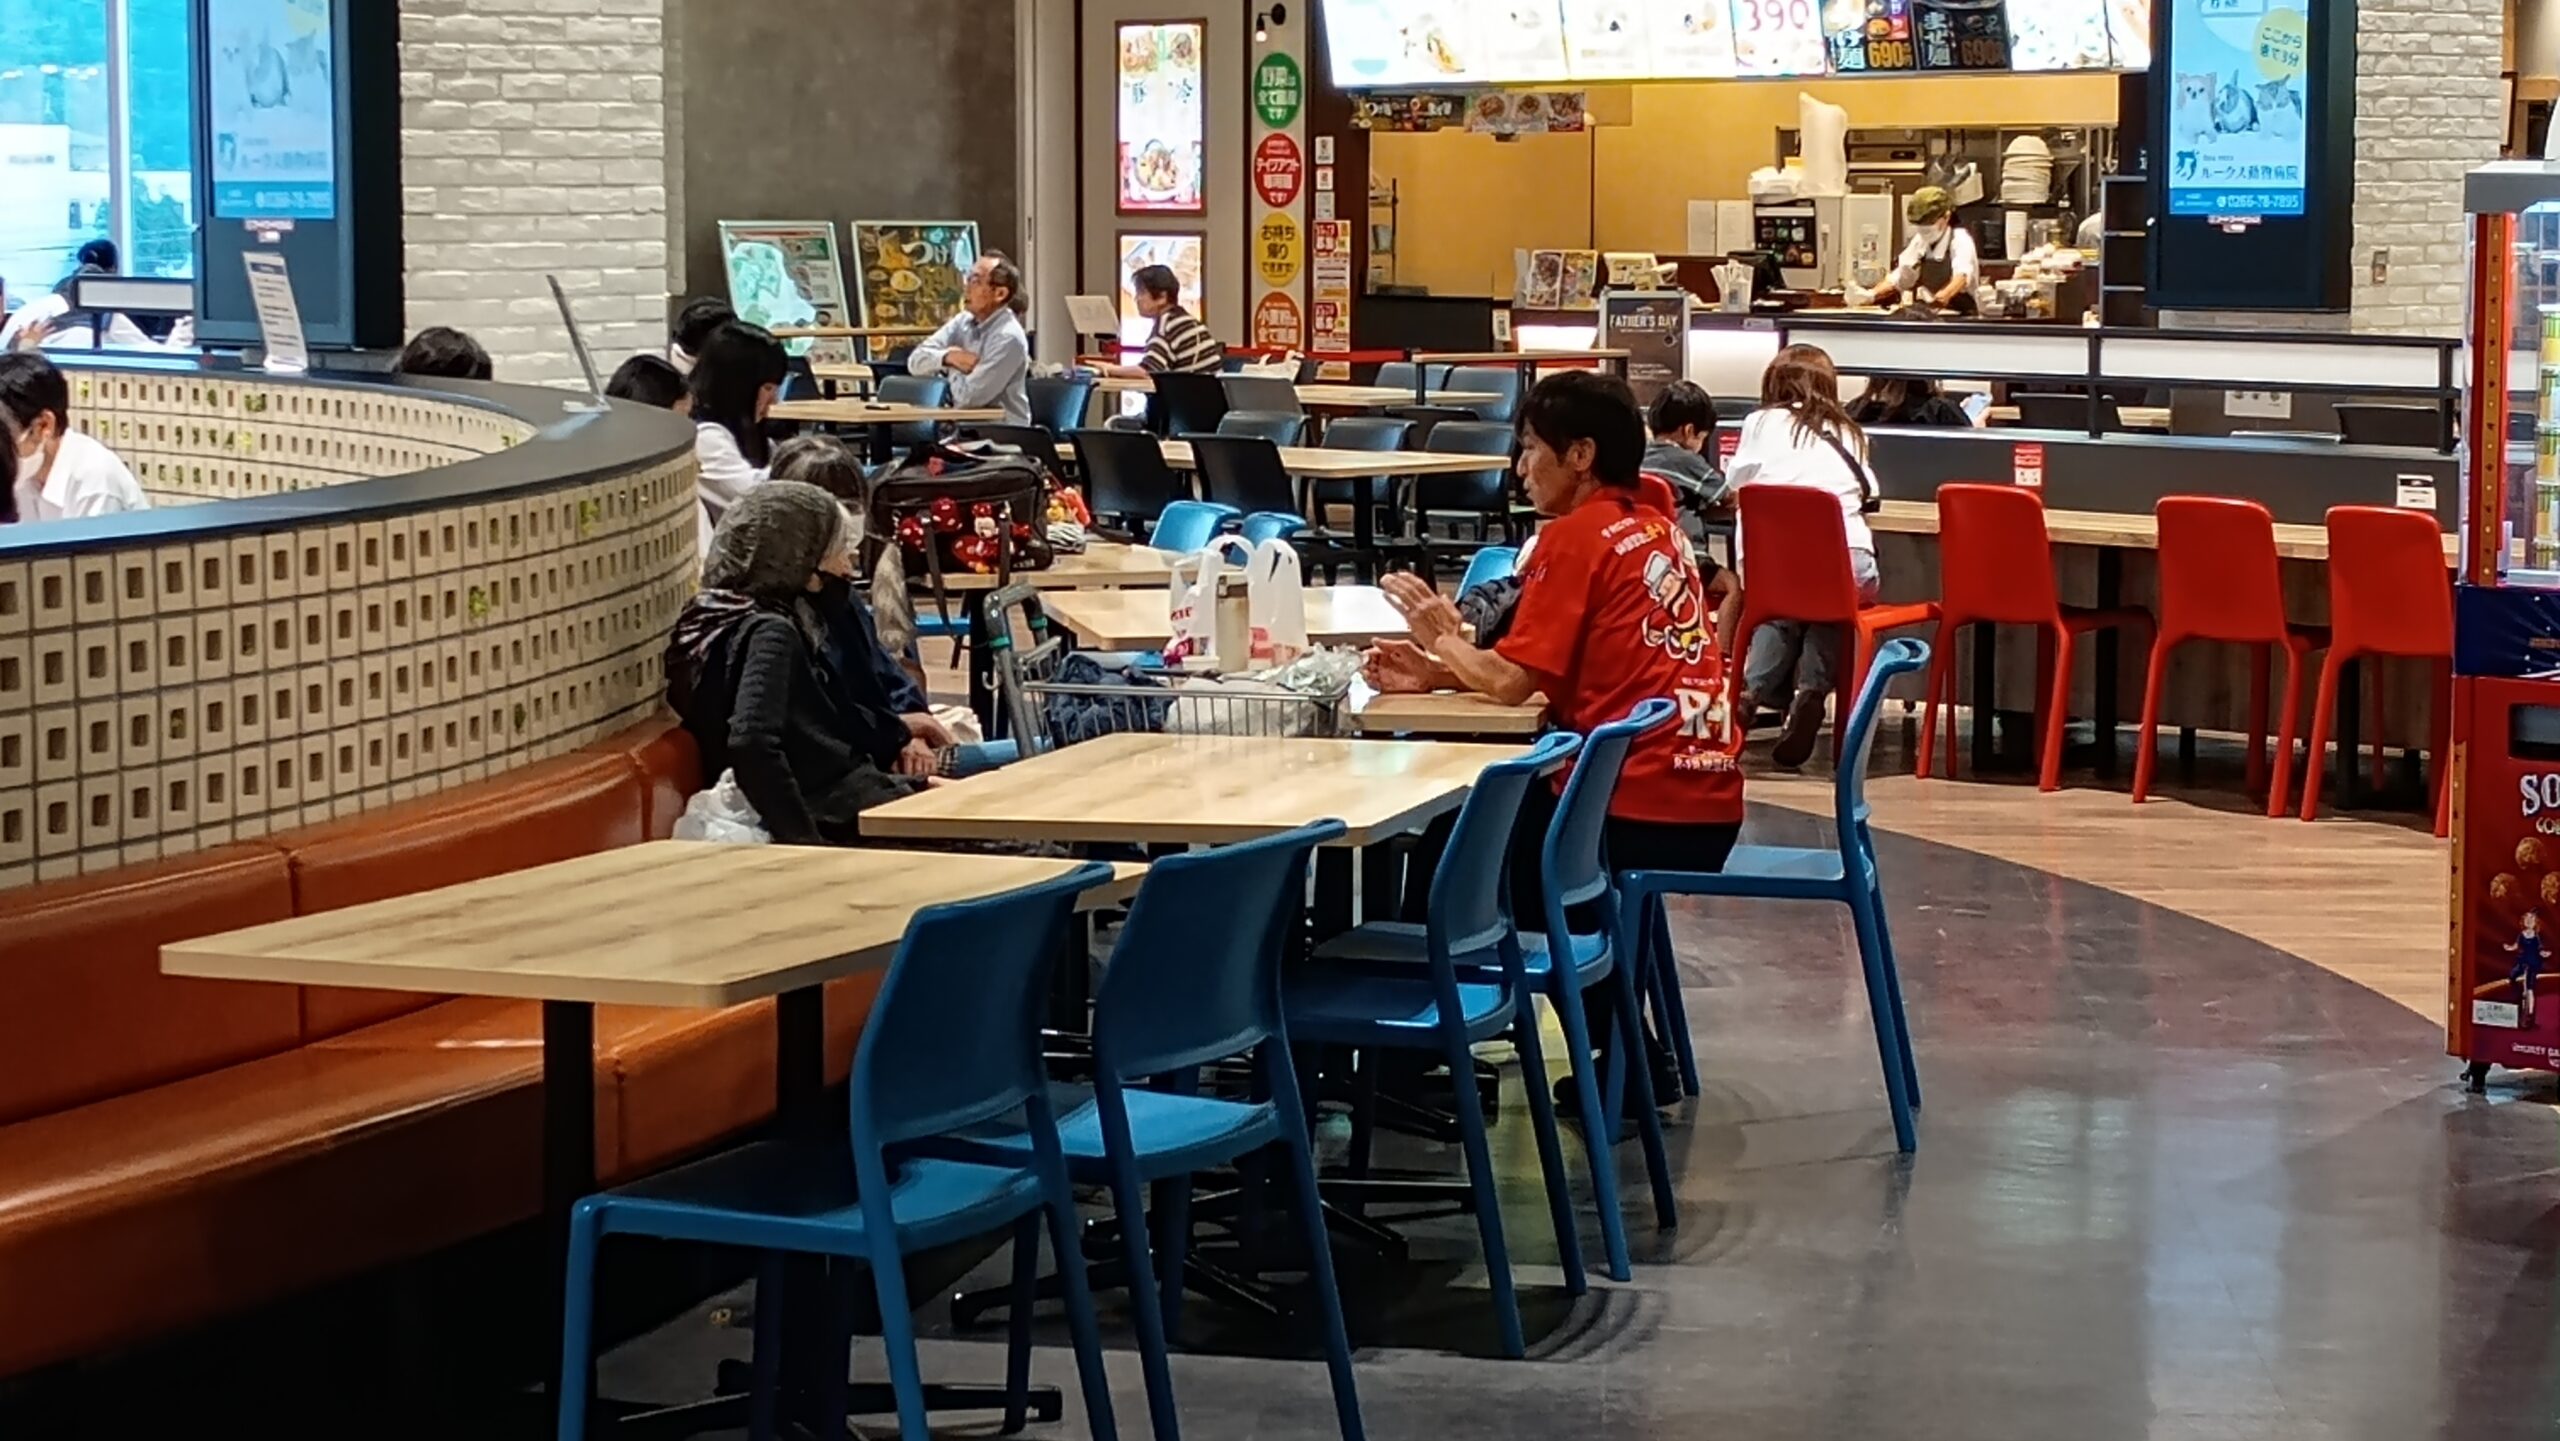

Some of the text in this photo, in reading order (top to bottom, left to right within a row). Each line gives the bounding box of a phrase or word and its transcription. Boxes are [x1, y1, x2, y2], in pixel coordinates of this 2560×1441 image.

[1743, 0, 1809, 31] 390
[1868, 41, 1903, 68] 690
[2202, 165, 2299, 181] ルークス動物病院
[1261, 224, 1295, 241] お持ち
[1267, 242, 1289, 260] 帰り
[1609, 314, 1679, 329] FATHER'S DAY
